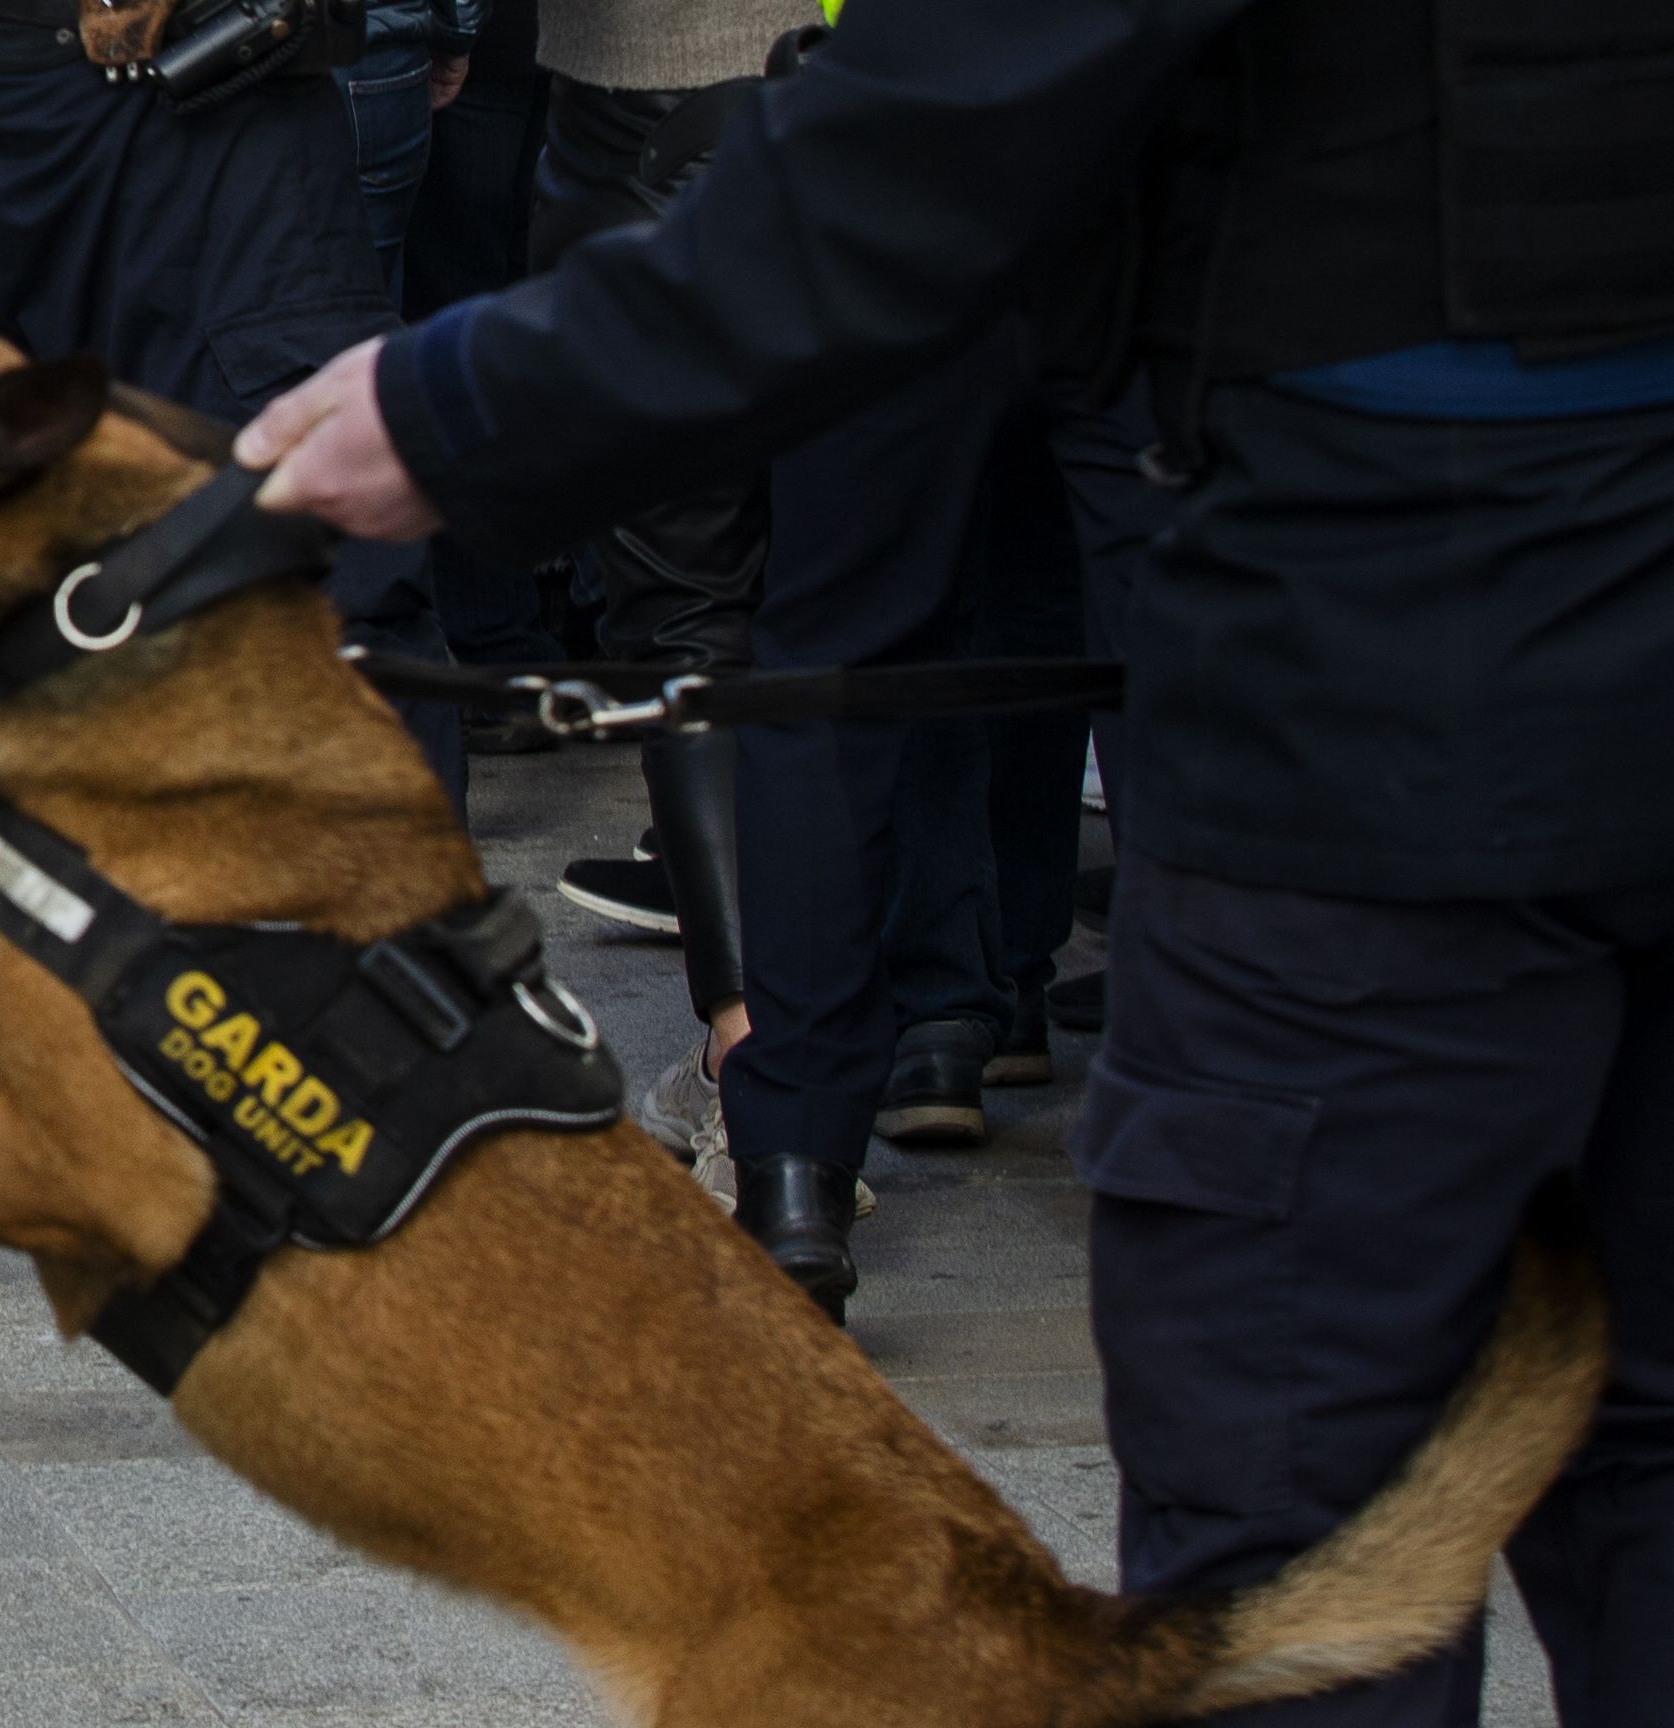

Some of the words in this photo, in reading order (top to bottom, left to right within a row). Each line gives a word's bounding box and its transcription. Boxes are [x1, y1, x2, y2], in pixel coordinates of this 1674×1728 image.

[157, 1025, 239, 1105] DOG
[232, 1094, 326, 1179] UNIT
[165, 970, 376, 1177] GARDA
